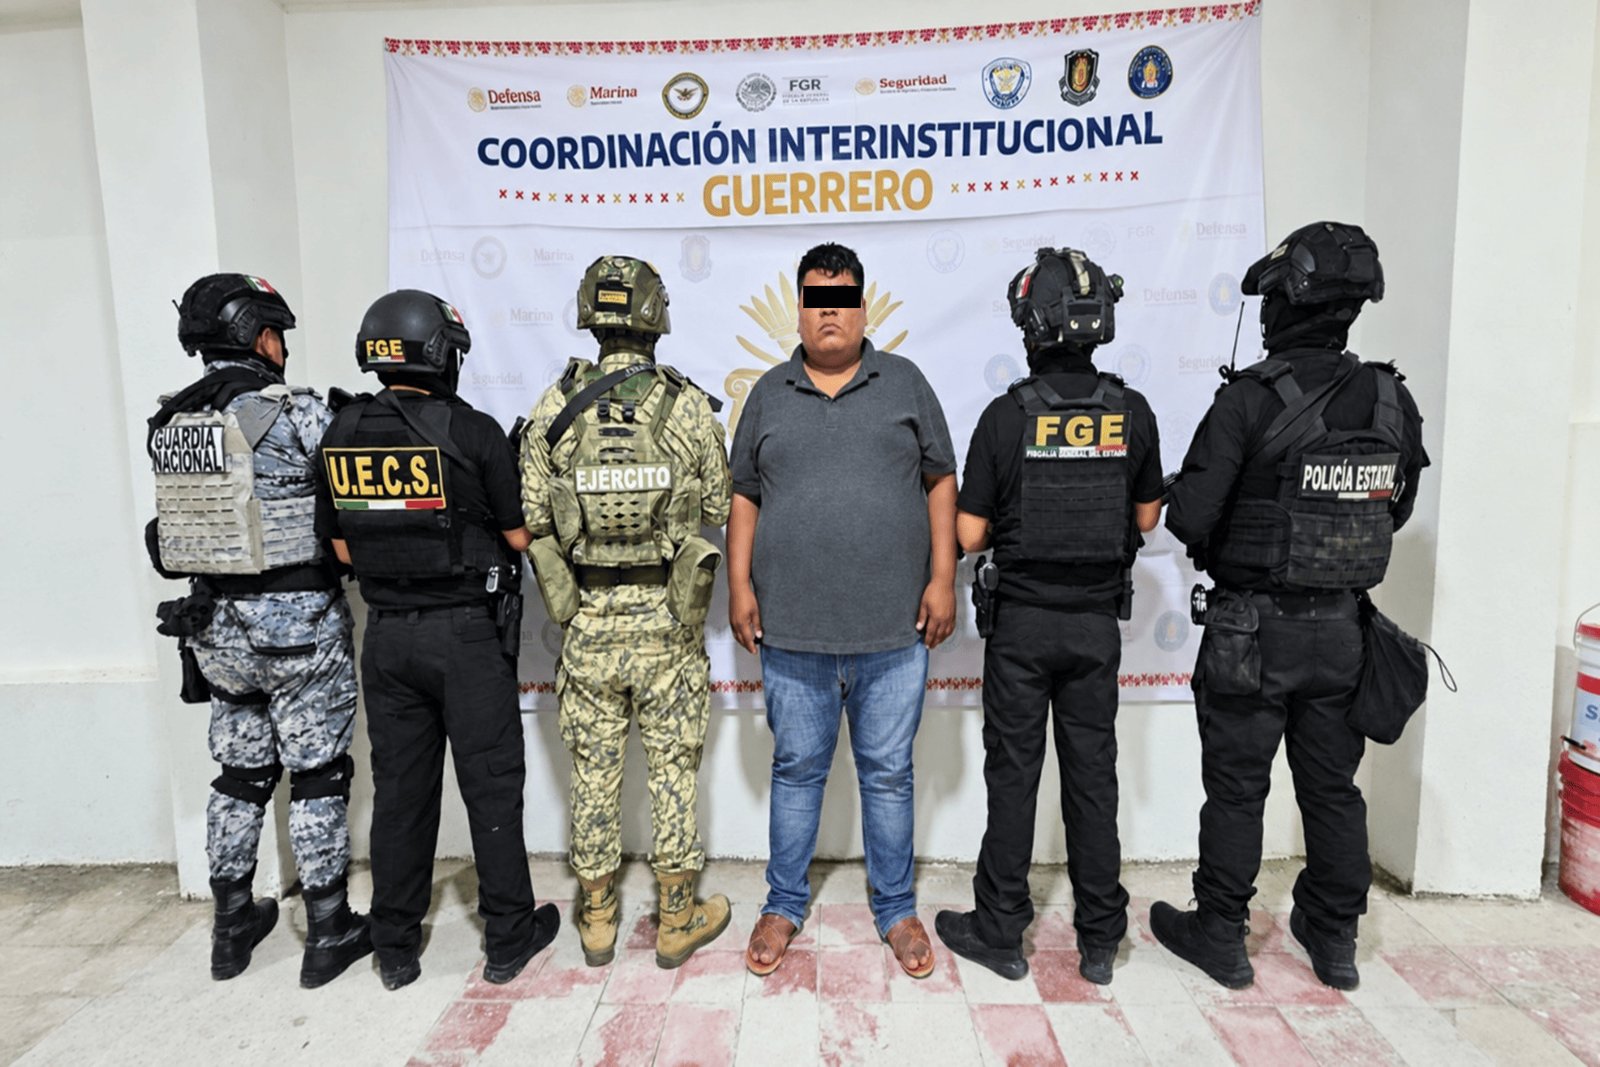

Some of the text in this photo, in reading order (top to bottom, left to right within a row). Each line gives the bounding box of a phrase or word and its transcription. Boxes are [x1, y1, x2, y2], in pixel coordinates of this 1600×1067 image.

[789, 79, 821, 91] FGR
[880, 74, 947, 89] Seguridad
[488, 88, 541, 104] Defensa
[590, 86, 637, 99] Marina
[477, 111, 1163, 170] COORDINACIÓN INTERINSTITUCIONAL
[703, 168, 933, 217] GUERRERO
[1127, 225, 1155, 239] FGR
[1196, 222, 1247, 236] Defensa
[533, 248, 574, 262] Marina
[1143, 288, 1198, 302] Defensa
[510, 308, 553, 321] Marina
[366, 339, 403, 357] FGE
[1035, 414, 1124, 447] FGE
[1102, 448, 1127, 457] ESTADO
[153, 449, 222, 472] NACIONAL
[328, 454, 439, 496] U.E.C.S.
[576, 465, 671, 491] EJÉRCITO
[1302, 458, 1396, 491] POLICÍA ESTATAL
